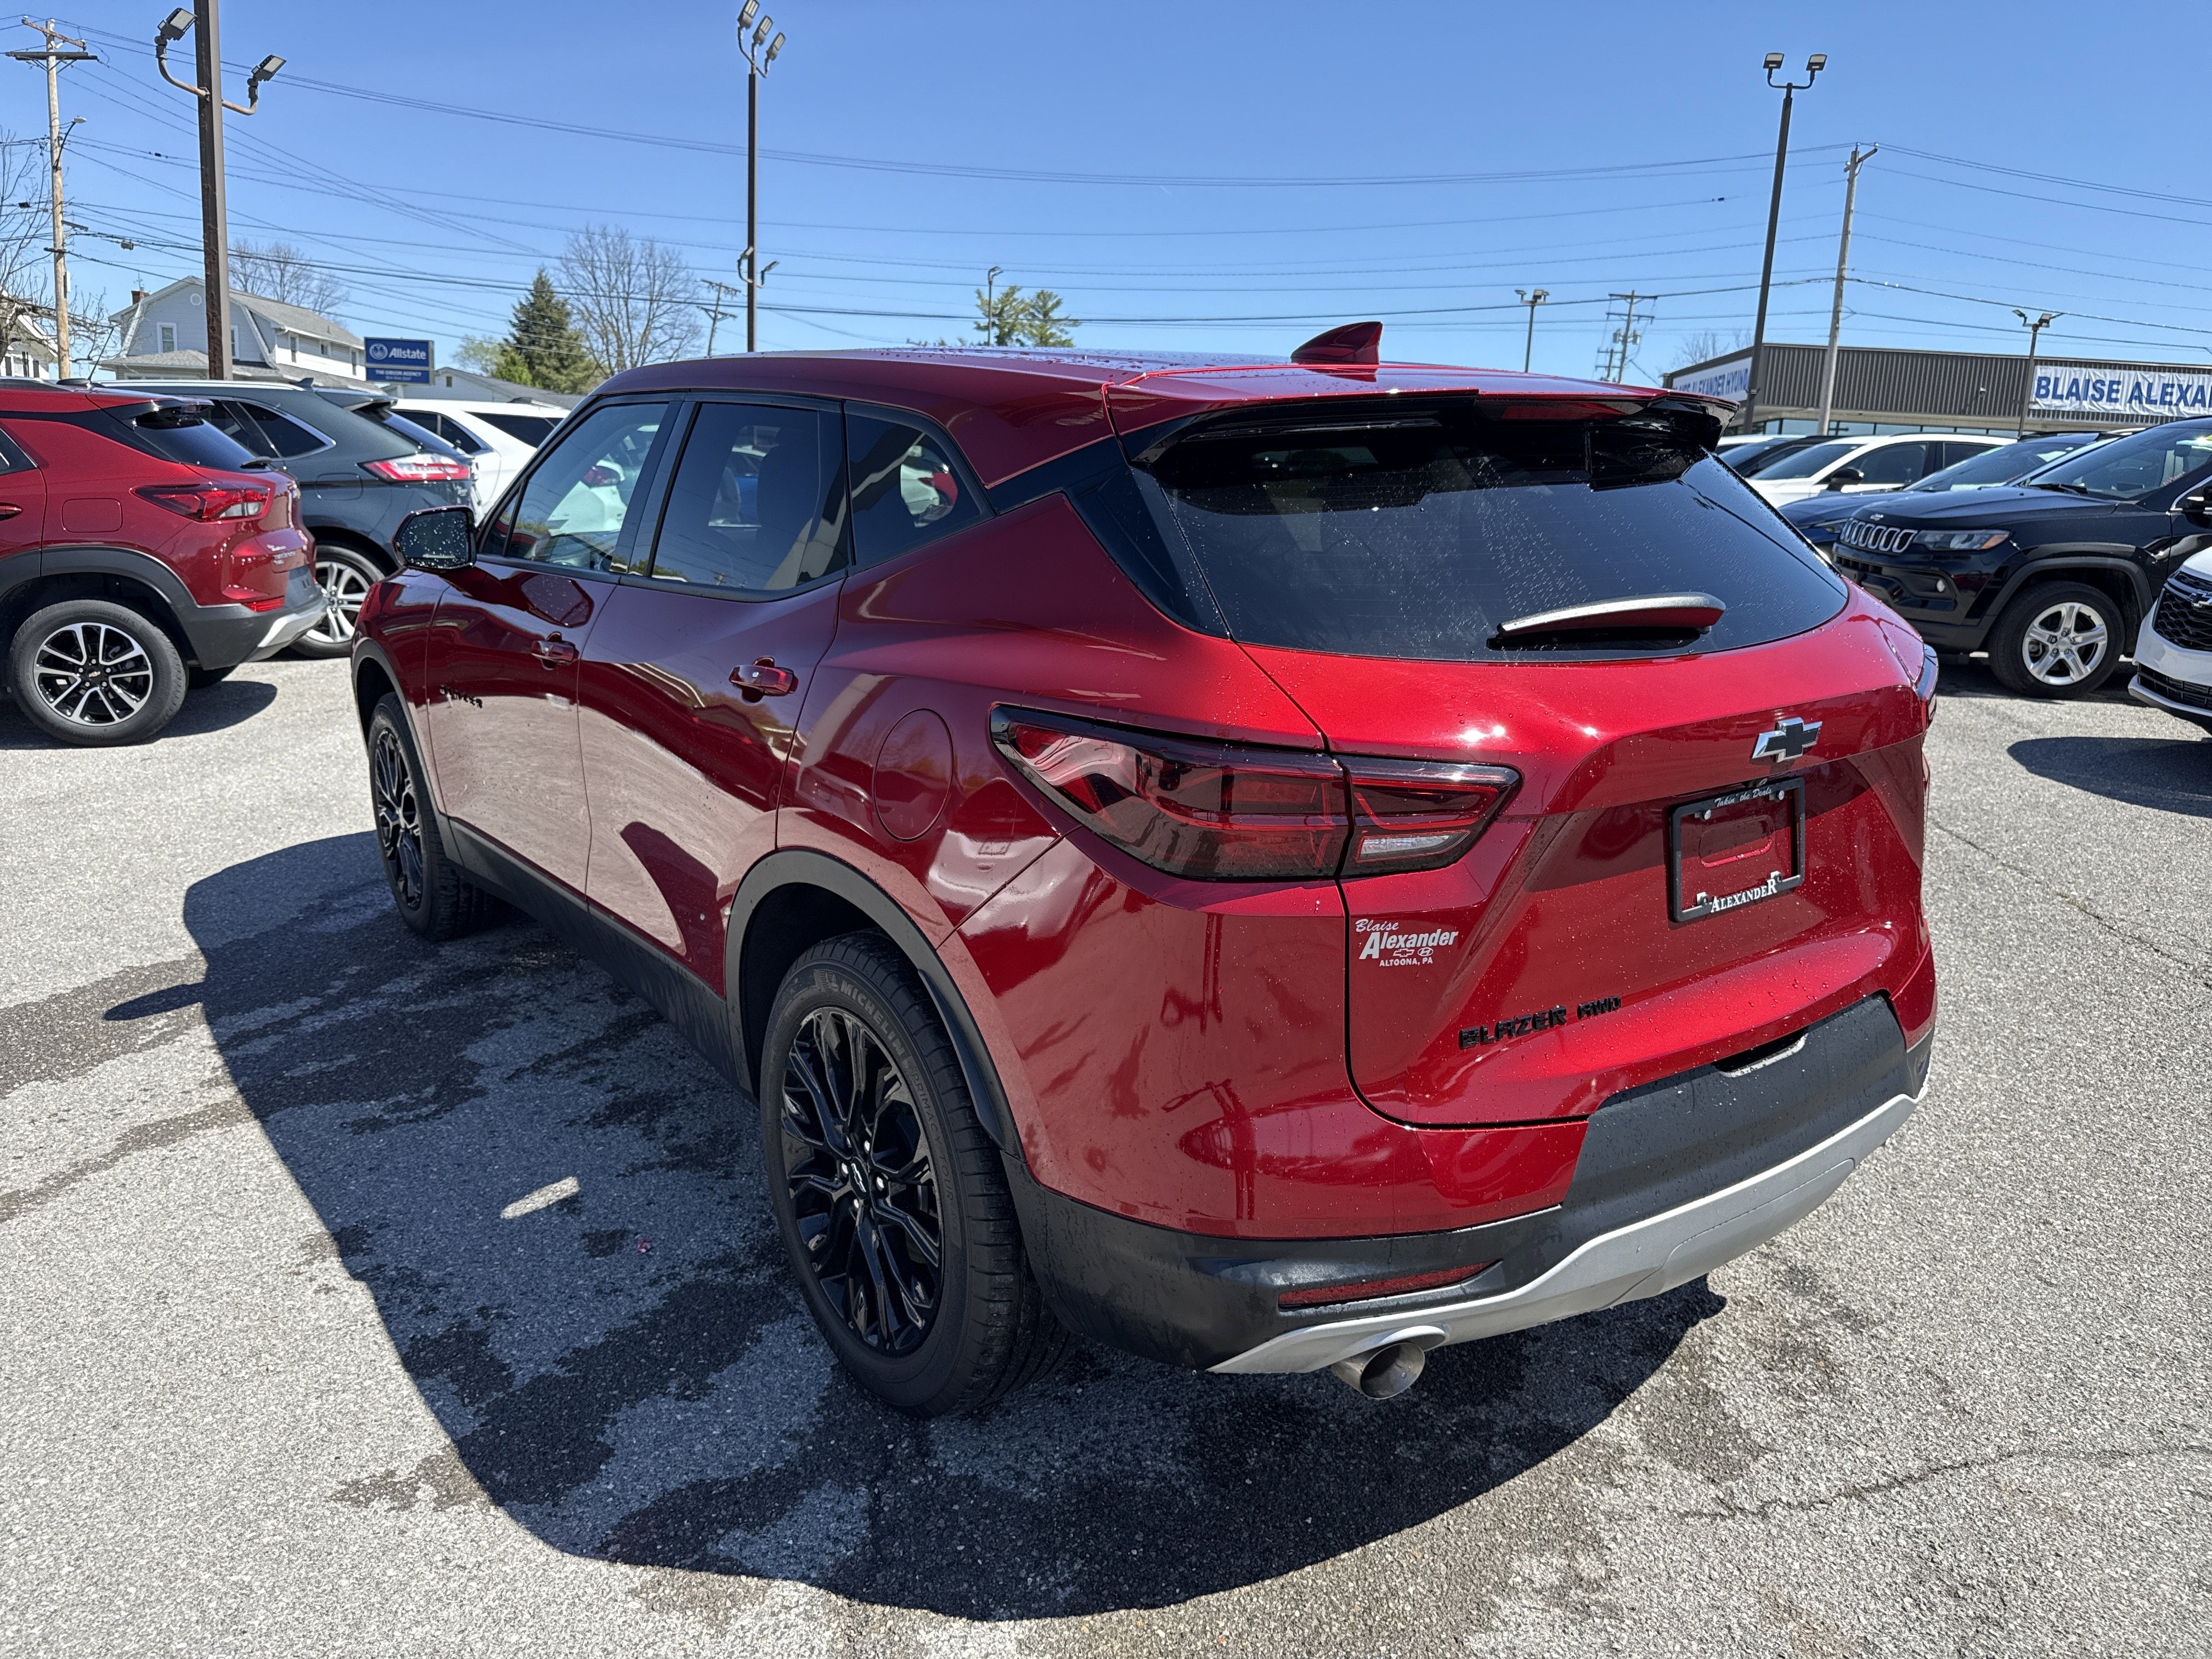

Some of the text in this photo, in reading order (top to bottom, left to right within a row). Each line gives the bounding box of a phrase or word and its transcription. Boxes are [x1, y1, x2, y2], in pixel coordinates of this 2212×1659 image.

[388, 347, 426, 360] Allstate
[2035, 376, 2212, 408] BLAISE ALEXA
[1714, 786, 1772, 808] Takin' the Deals
[1355, 918, 1399, 932] Blaise
[1358, 929, 1459, 960] Alexander
[1379, 958, 1420, 967] ALTOONA,
[840, 979, 906, 1057] MICHELIN
[1458, 995, 1622, 1051] BLAZER AWD
[911, 1071, 943, 1146] PRIMACY
[939, 1154, 953, 1201] TOUR
